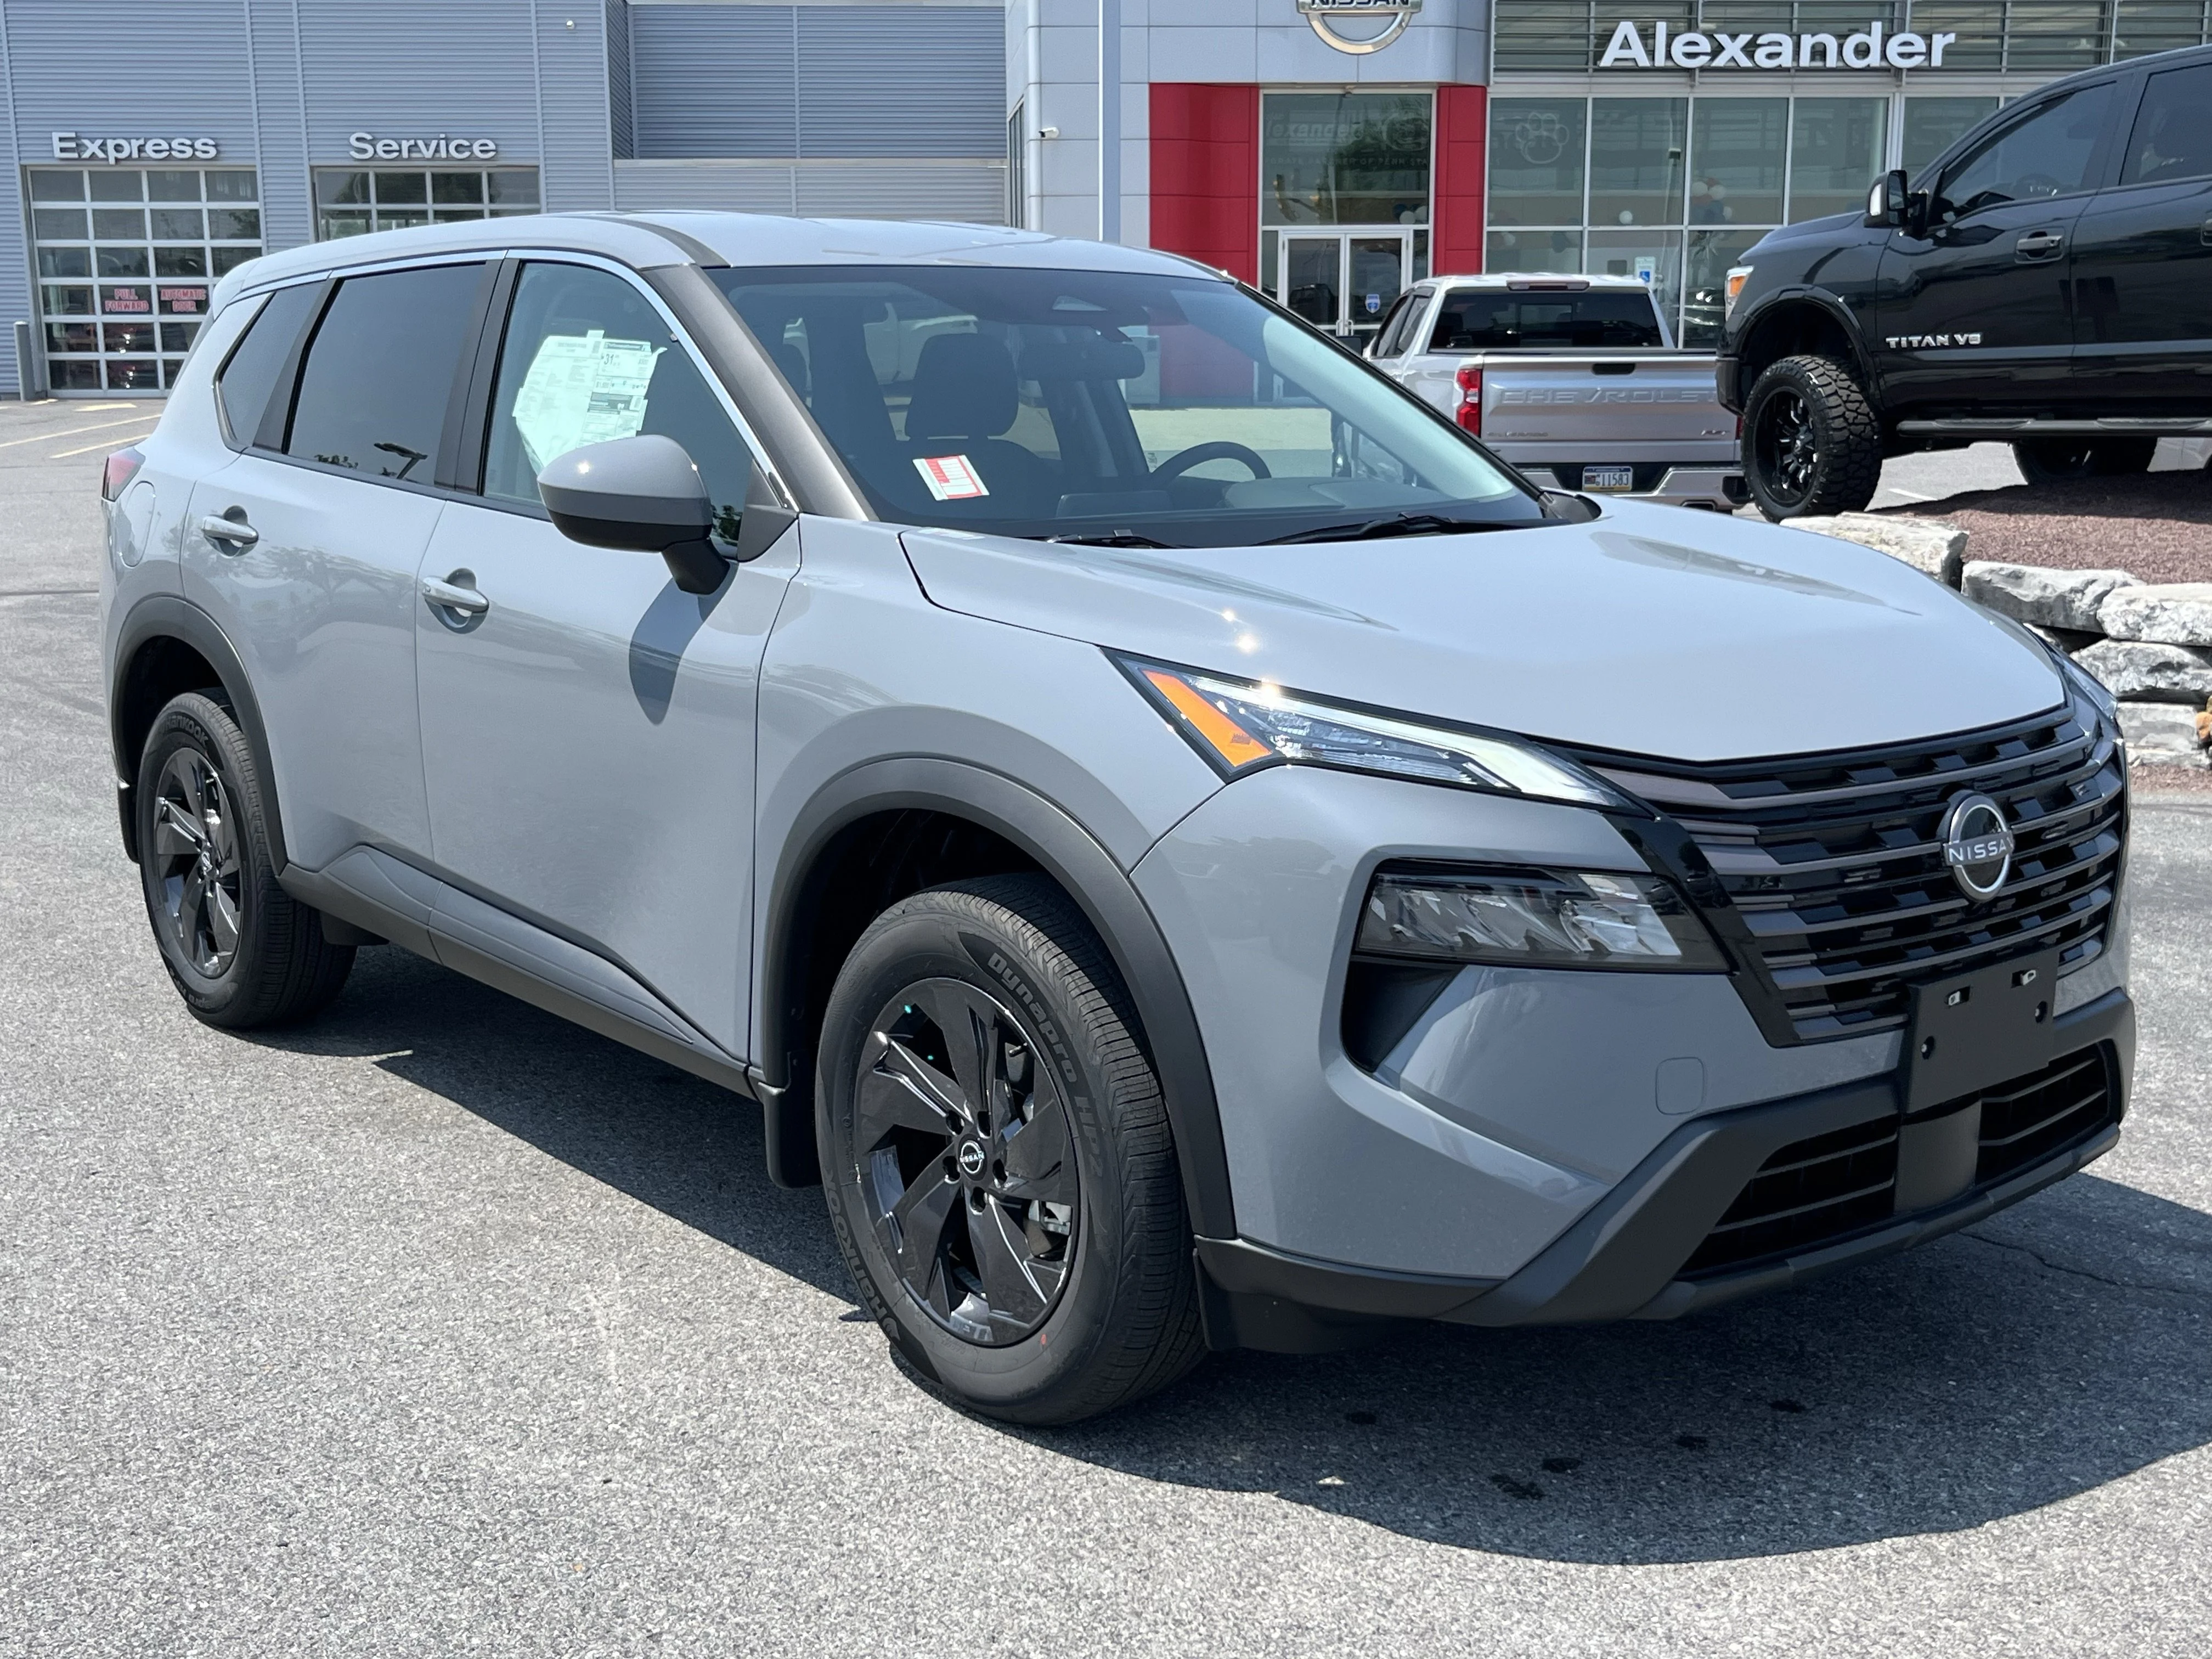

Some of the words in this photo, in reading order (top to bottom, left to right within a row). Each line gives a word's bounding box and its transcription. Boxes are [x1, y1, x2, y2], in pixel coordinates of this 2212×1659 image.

[1599, 21, 1956, 69] Alexander
[52, 132, 218, 165] Express
[349, 132, 496, 159] Service
[105, 301, 149, 312] FORWARD
[114, 288, 138, 300] PULL
[1885, 335, 1950, 349] TITAN
[1953, 332, 1982, 346] V8
[1948, 836, 2015, 862] NISSAN
[987, 952, 1078, 1083] Dynapro
